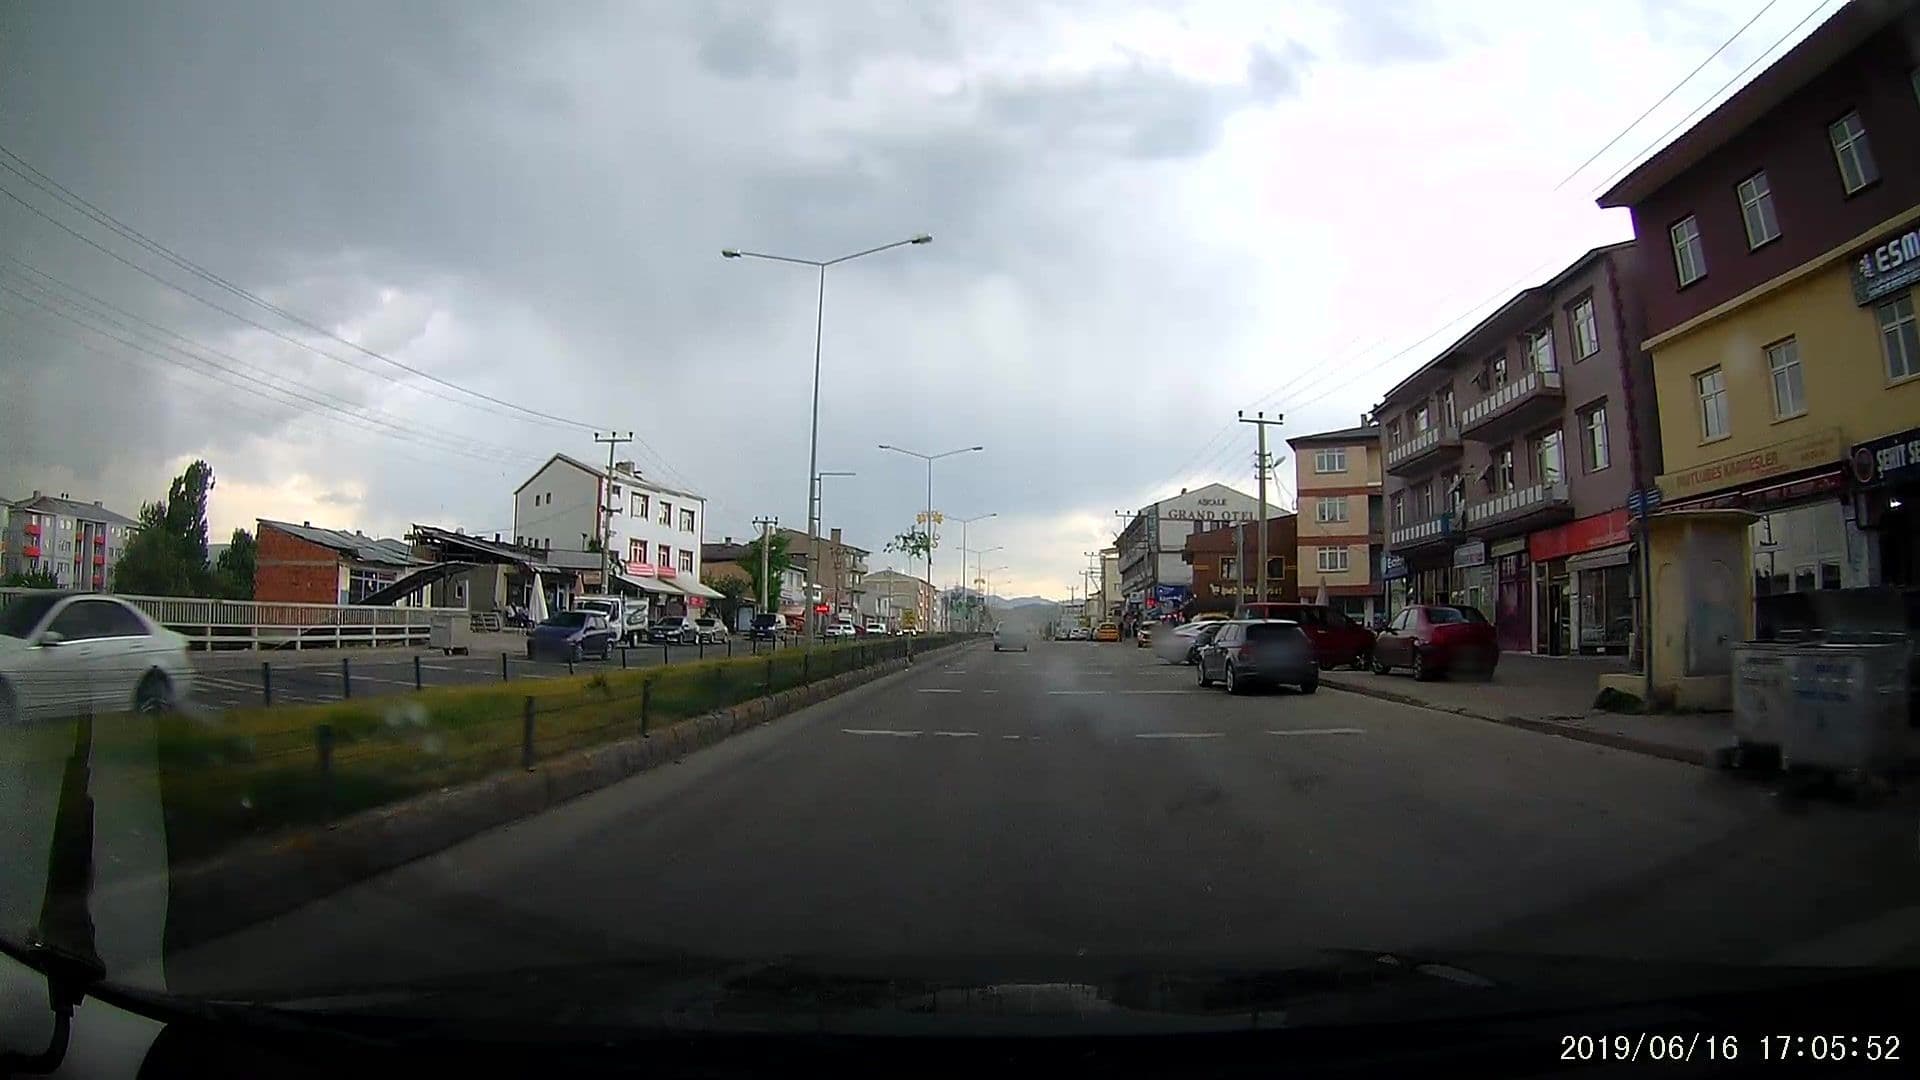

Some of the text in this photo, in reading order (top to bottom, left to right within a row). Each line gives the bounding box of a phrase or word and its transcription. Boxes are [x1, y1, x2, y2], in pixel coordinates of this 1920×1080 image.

[1875, 229, 1920, 273] ESM
[1168, 509, 1254, 521] GRAND OTEL
